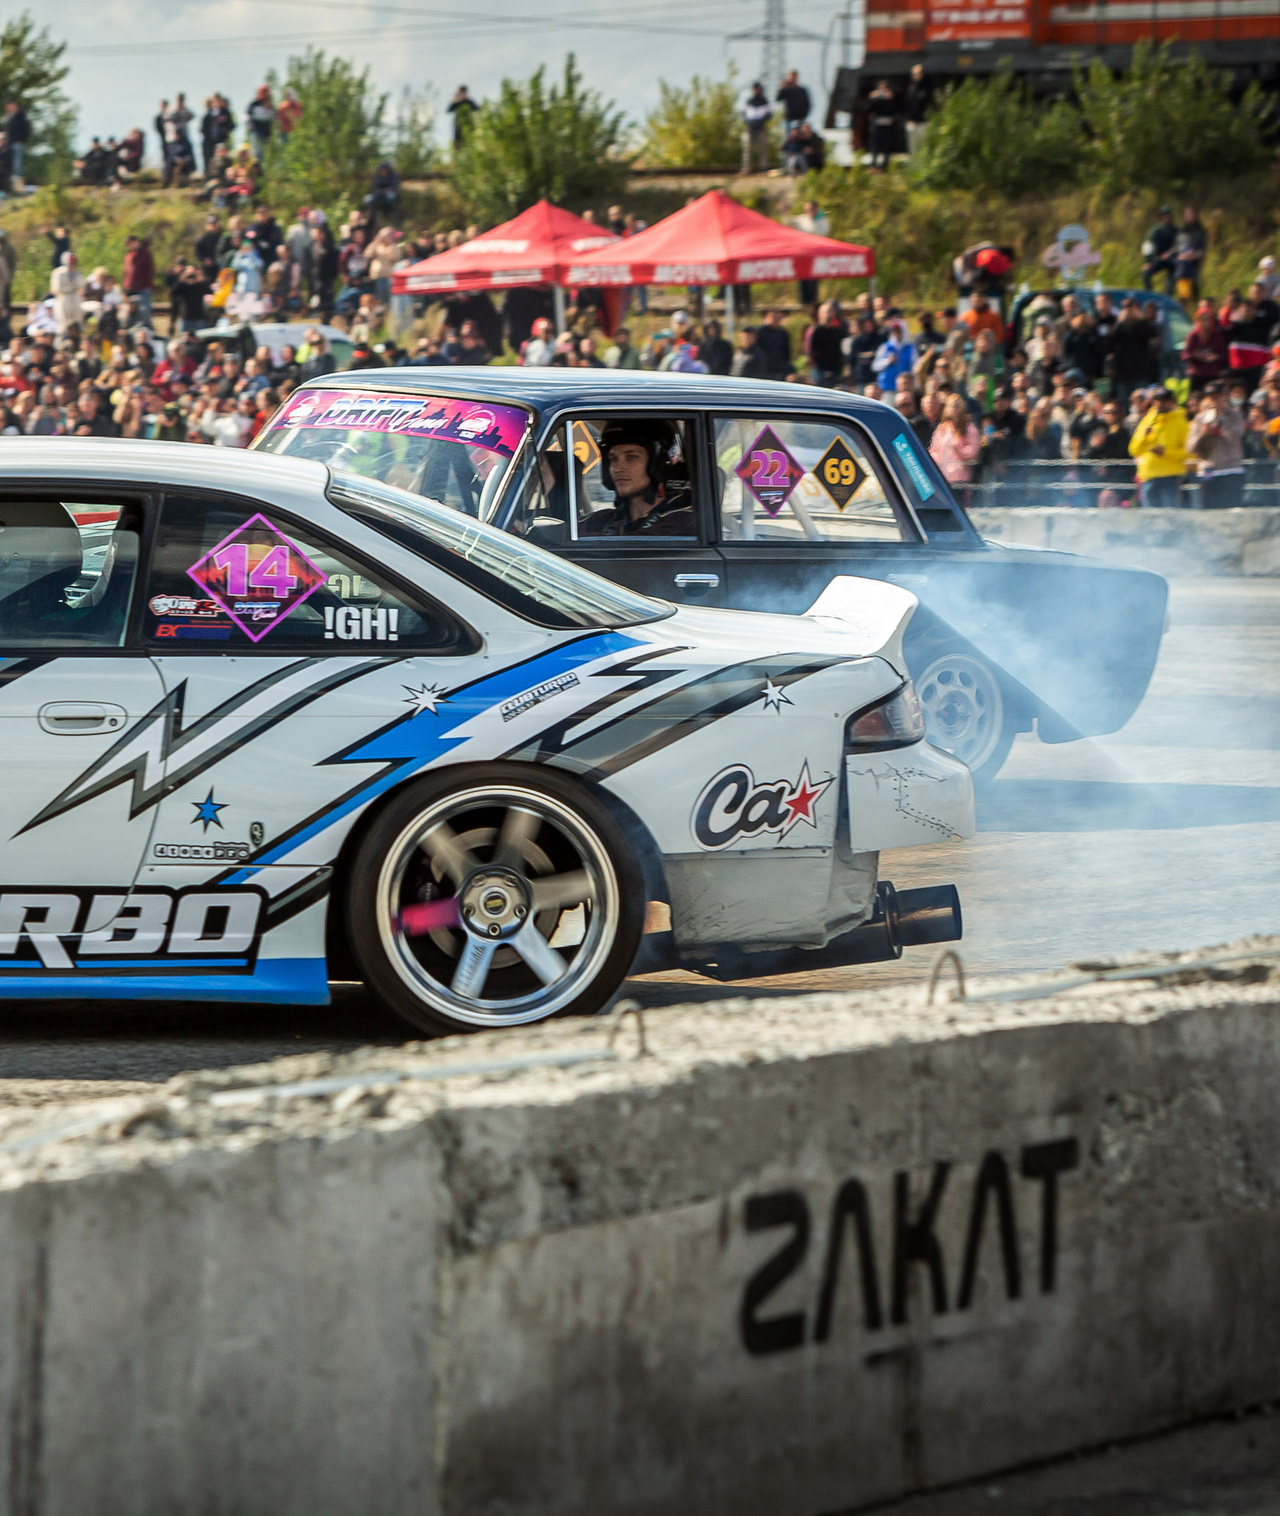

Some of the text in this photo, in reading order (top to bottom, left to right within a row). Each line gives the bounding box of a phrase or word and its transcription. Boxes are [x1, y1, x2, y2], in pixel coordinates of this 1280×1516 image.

[567, 264, 633, 284] MOTUL
[736, 258, 796, 280] MOTUL
[811, 254, 868, 276] MOTUL
[751, 449, 790, 486] 22
[823, 457, 857, 486] 69
[213, 543, 297, 598] 14
[324, 606, 399, 641] !GH!
